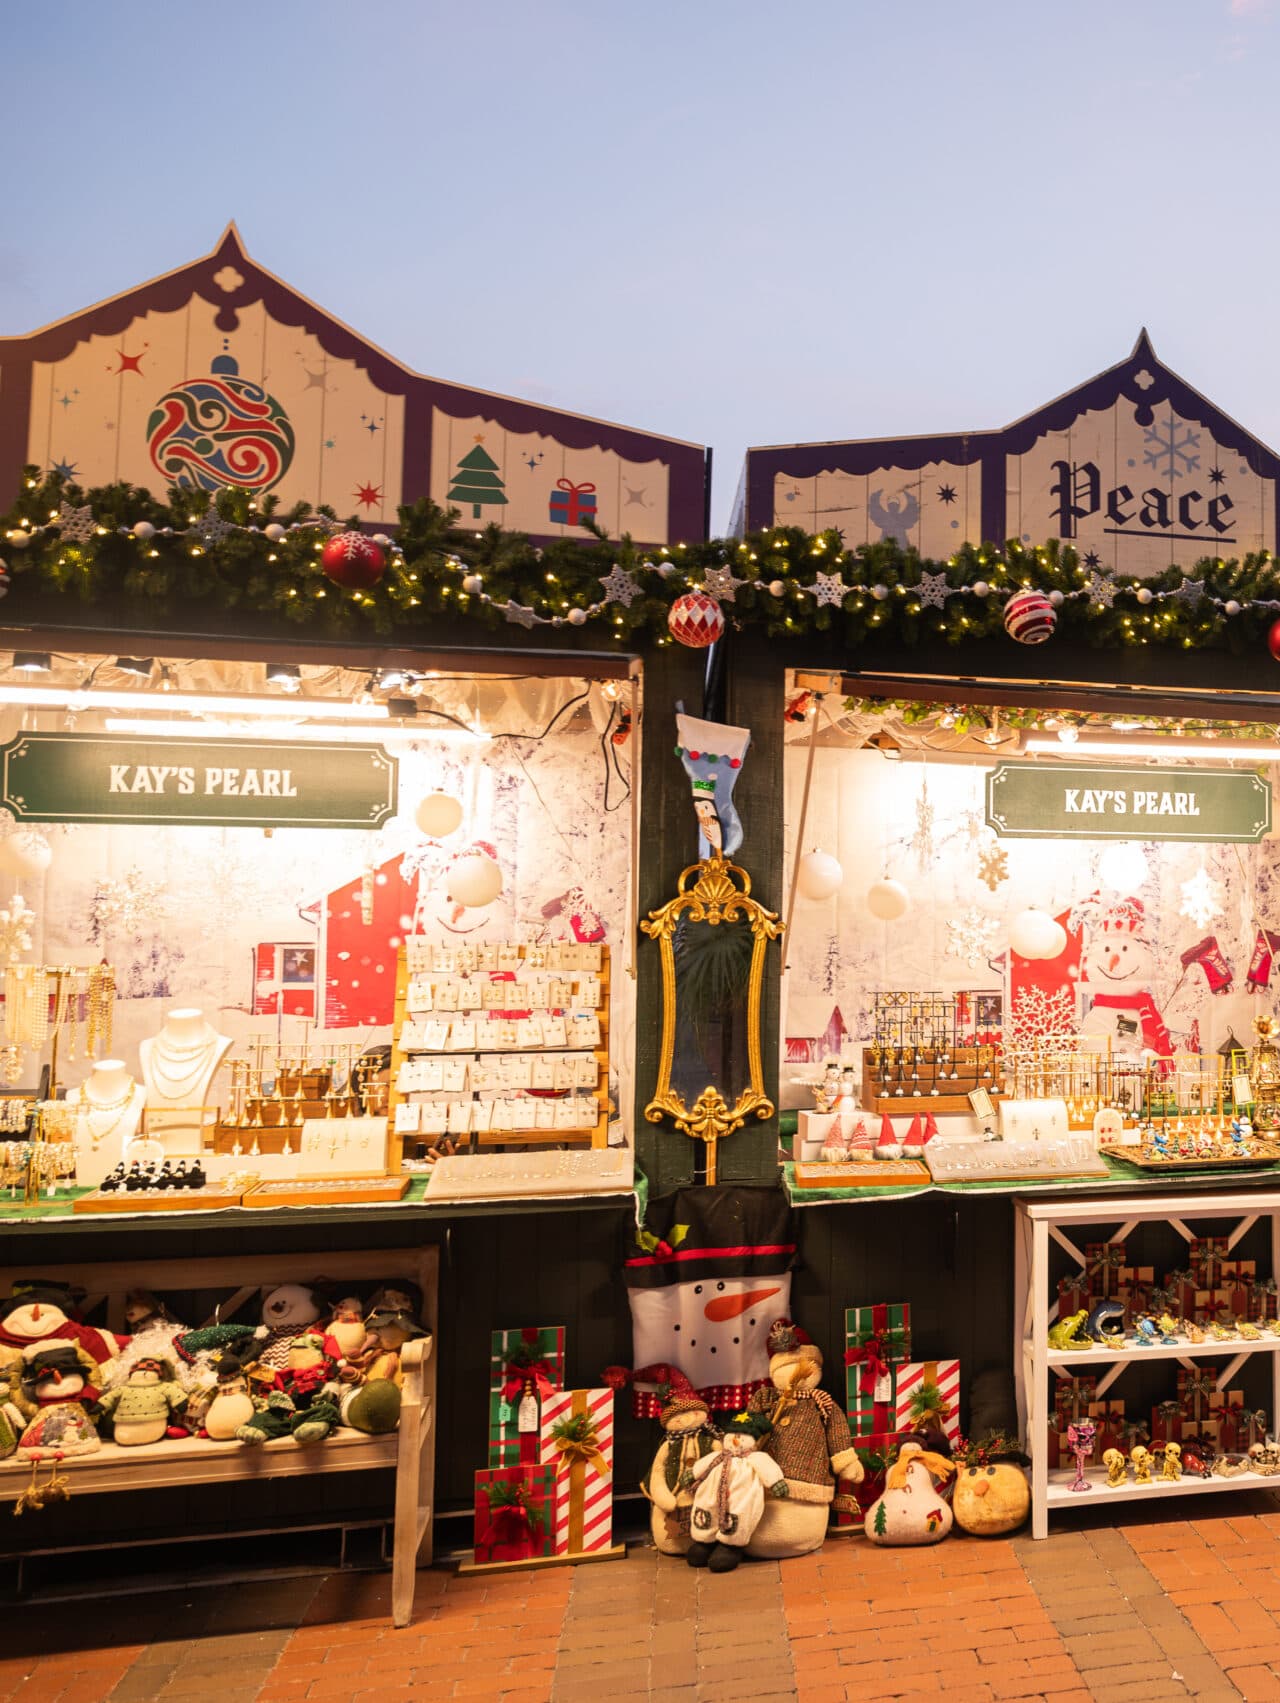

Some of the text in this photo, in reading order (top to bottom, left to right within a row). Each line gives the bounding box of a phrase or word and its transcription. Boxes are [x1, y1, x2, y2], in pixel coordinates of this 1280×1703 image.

[1049, 460, 1236, 539] Peace
[109, 764, 298, 797] KAY'S PEARL
[1064, 788, 1200, 816] KAY'S PEARL
